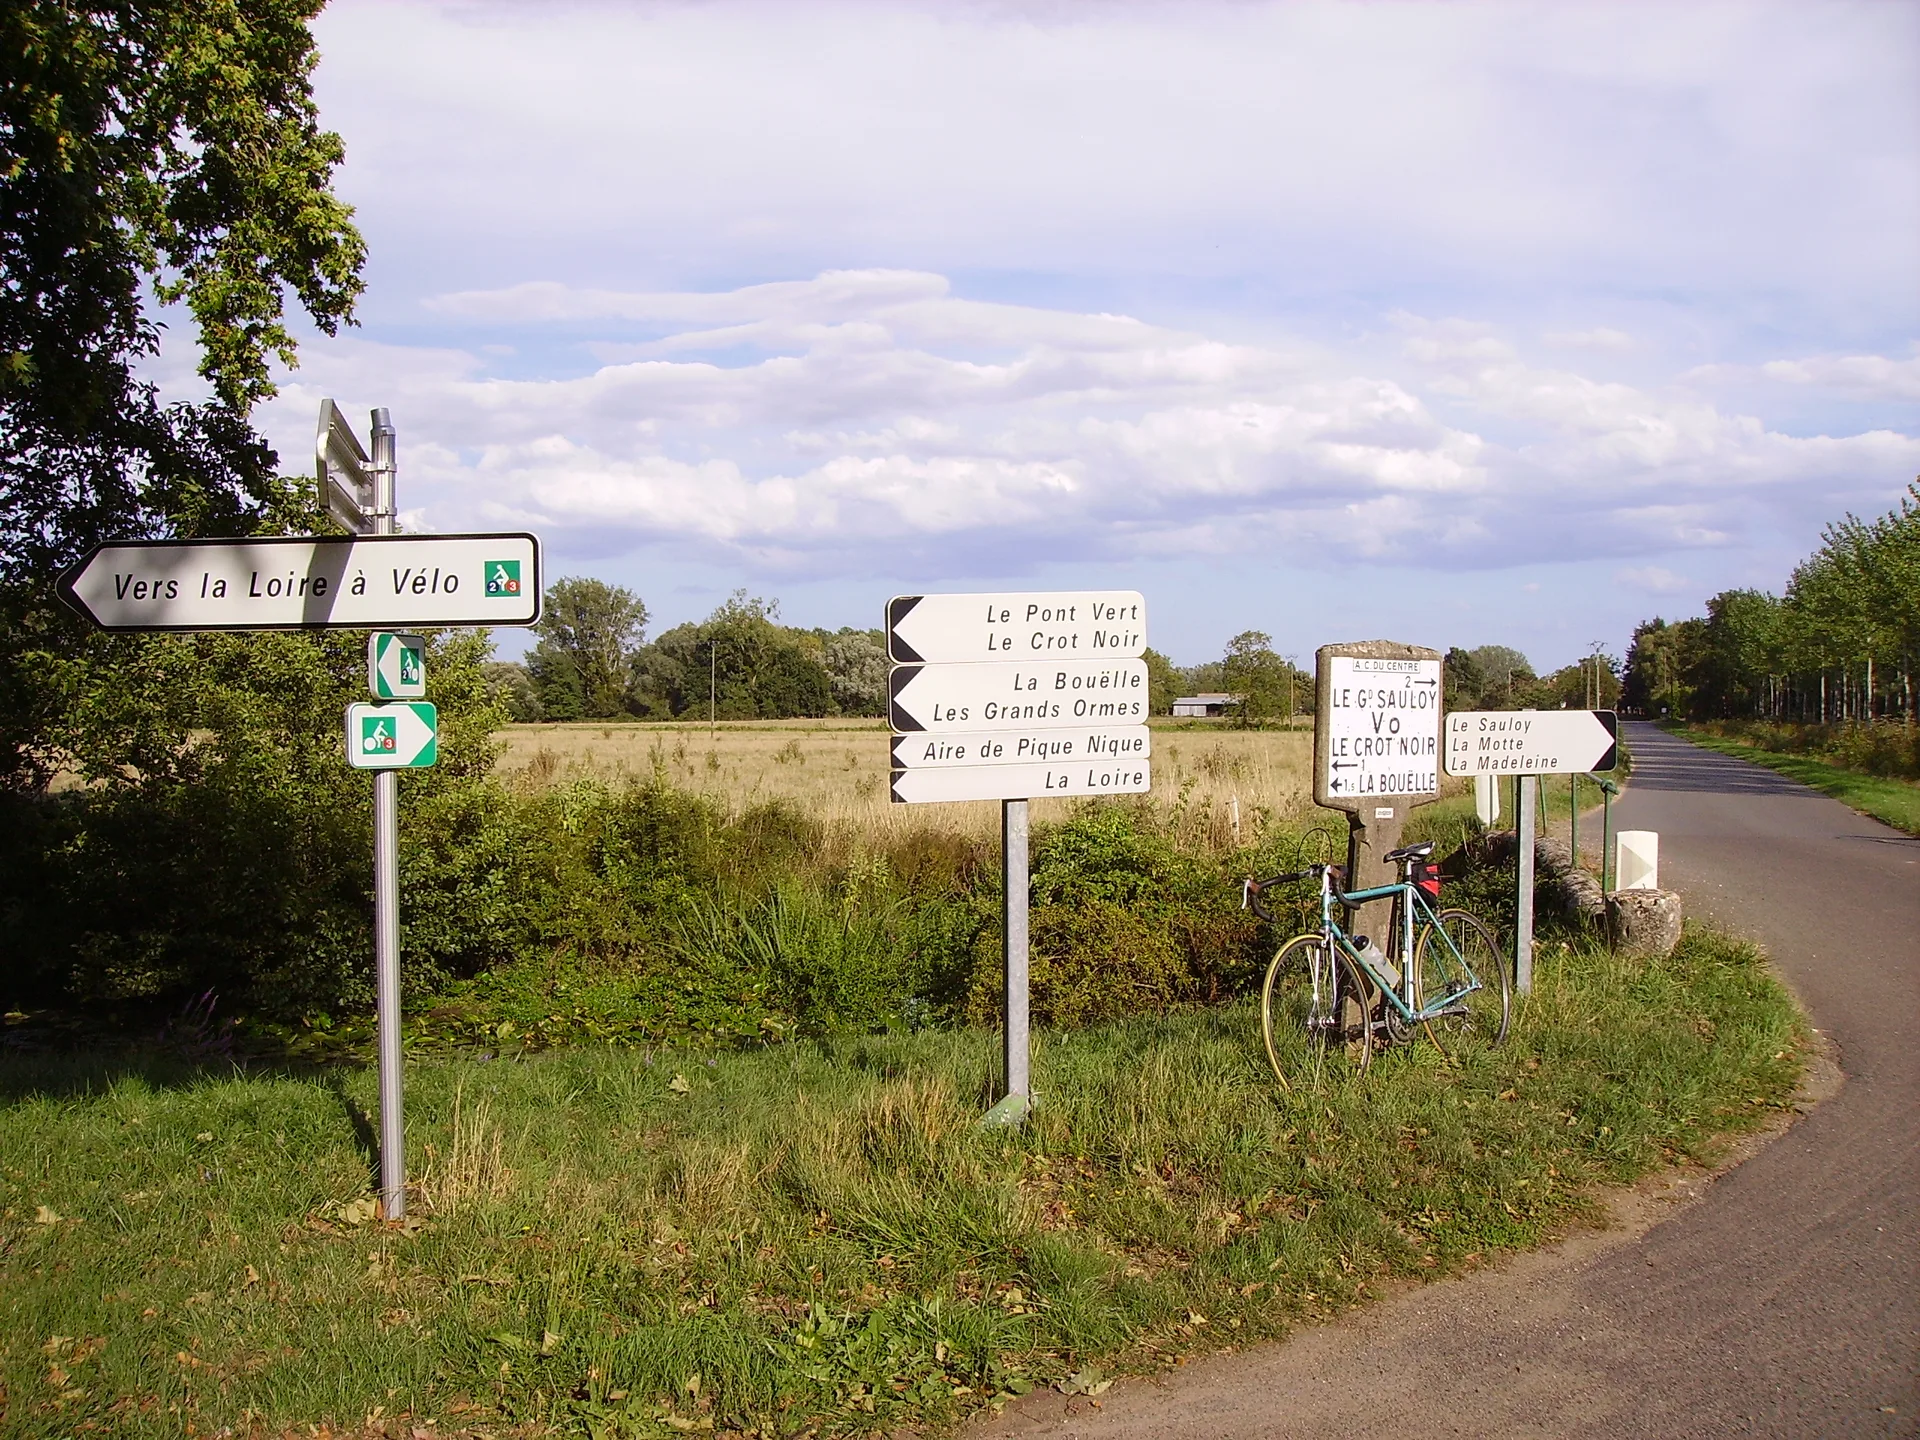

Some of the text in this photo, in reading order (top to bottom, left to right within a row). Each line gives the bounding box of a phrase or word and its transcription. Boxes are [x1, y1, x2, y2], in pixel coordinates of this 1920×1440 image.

[114, 567, 459, 600] Vers la Loire à Vélo
[488, 582, 497, 592] 2
[508, 581, 517, 591] 3
[987, 602, 1138, 623] Le Pont Vert
[988, 630, 1139, 651] Le Crot Noir
[1386, 661, 1418, 671] CENTRE
[1014, 670, 1141, 691] La Bouëlle
[1405, 675, 1411, 688] 2
[1333, 688, 1350, 707] LE
[1377, 689, 1437, 709] SAULOY
[933, 699, 1140, 722] Les Grands Ormes
[1452, 717, 1531, 734] Le Sauloy
[385, 738, 393, 749] 3
[923, 735, 1143, 761] Aire de Pique Nique
[1332, 736, 1436, 756] LE CROT NOIR
[1452, 736, 1524, 752] La Motte
[1451, 755, 1558, 771] La Madeleine
[1045, 768, 1143, 789] La Loire
[1359, 774, 1374, 793] LA
[1380, 770, 1436, 793] BOUËLLE
